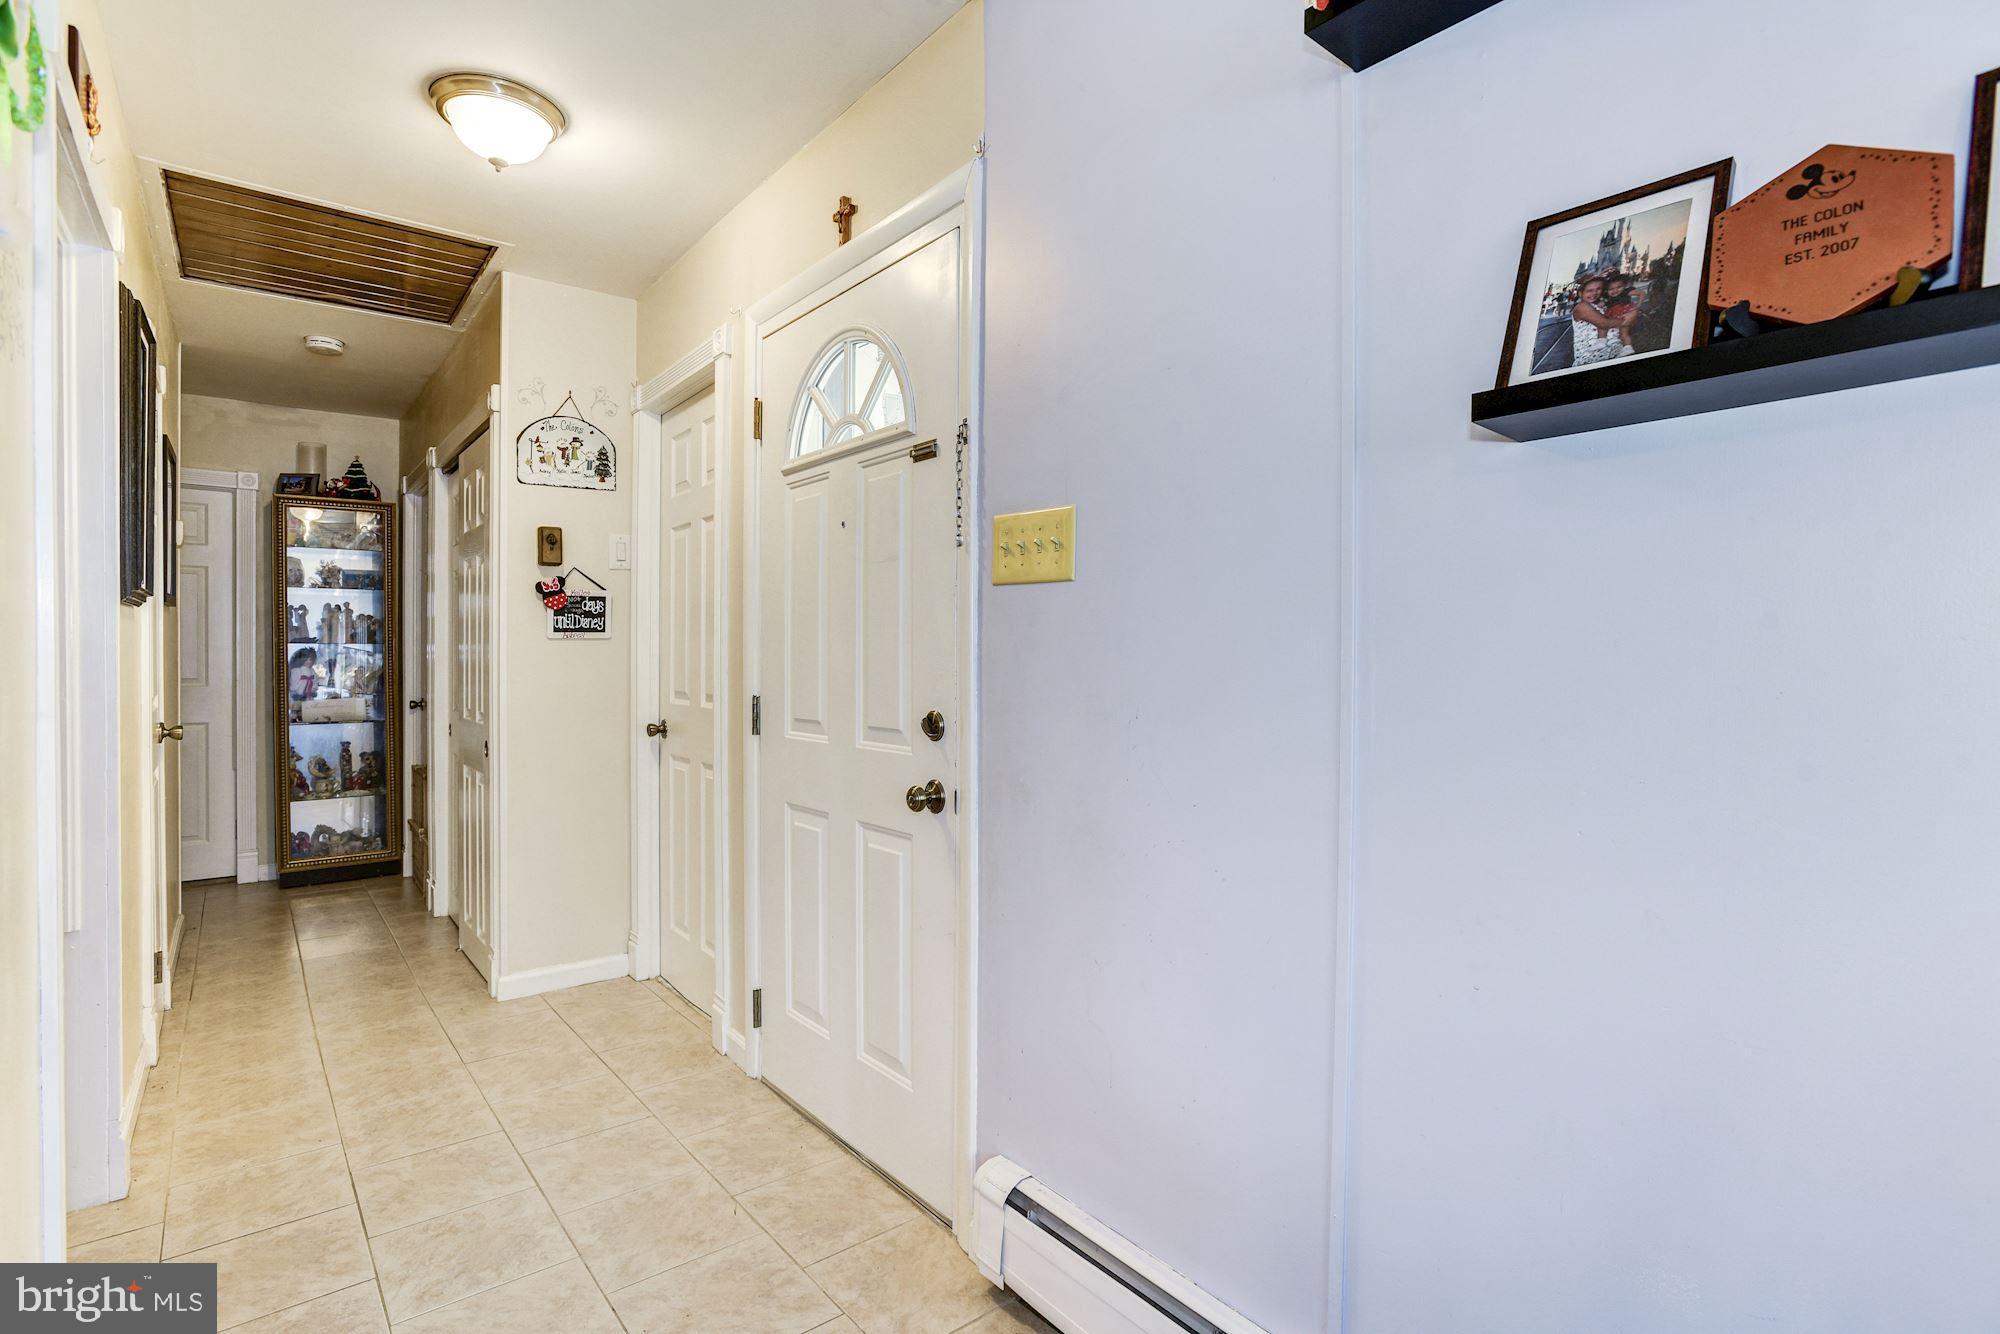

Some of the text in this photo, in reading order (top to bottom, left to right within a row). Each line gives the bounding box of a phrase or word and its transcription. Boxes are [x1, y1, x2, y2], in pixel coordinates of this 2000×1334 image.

[1780, 200, 1864, 231] THE COLON
[1794, 221, 1849, 244] FAMILY
[1784, 237, 1860, 265] EST. 2007
[542, 420, 557, 432] The
[581, 596, 604, 614] days
[553, 613, 604, 630] until Disney
